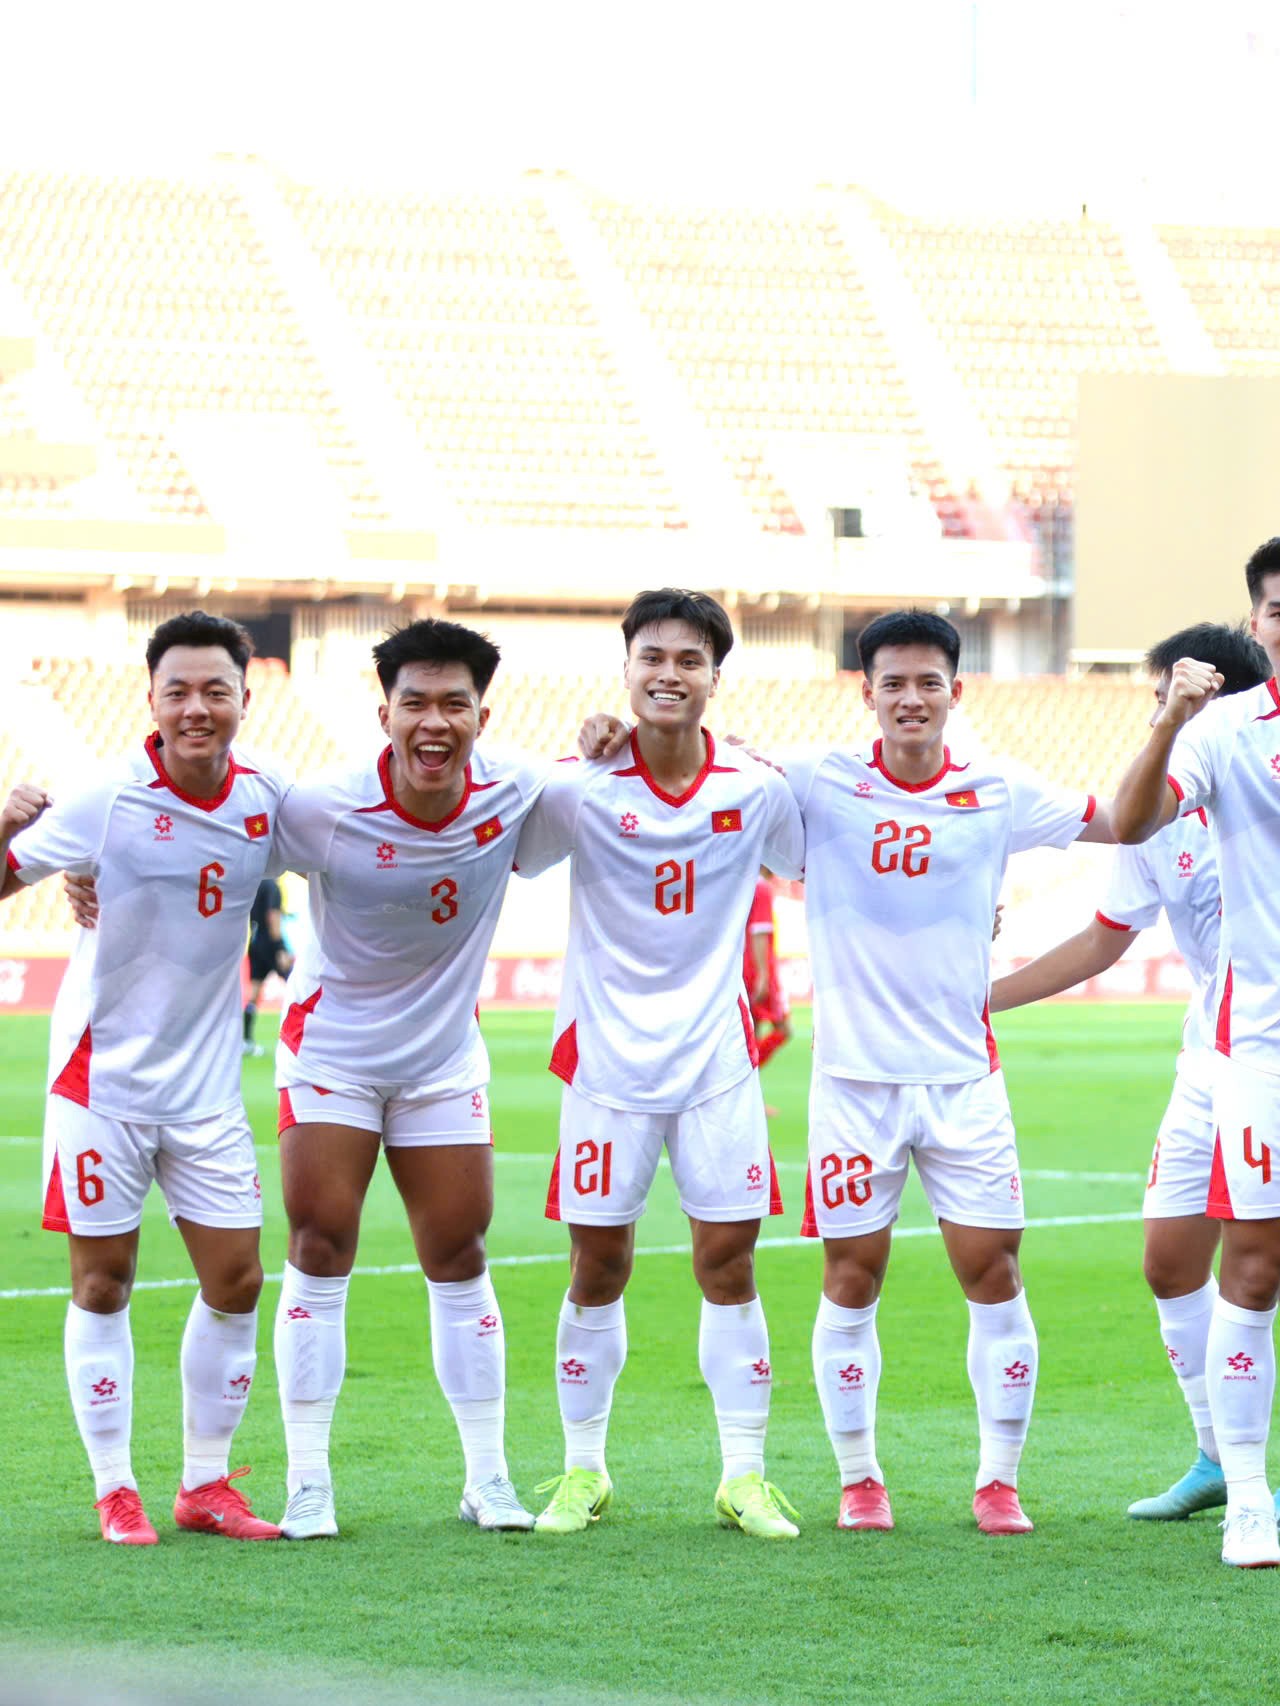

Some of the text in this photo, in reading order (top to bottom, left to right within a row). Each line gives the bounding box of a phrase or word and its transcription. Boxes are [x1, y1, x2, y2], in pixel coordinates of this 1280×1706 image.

[870, 820, 931, 878] 22
[198, 862, 225, 918] 6
[431, 878, 458, 925] 3
[655, 859, 694, 915] 21
[76, 1148, 105, 1207] 6
[574, 1139, 612, 1198] 21
[821, 1153, 873, 1210] 22
[1243, 1126, 1271, 1185] 4
